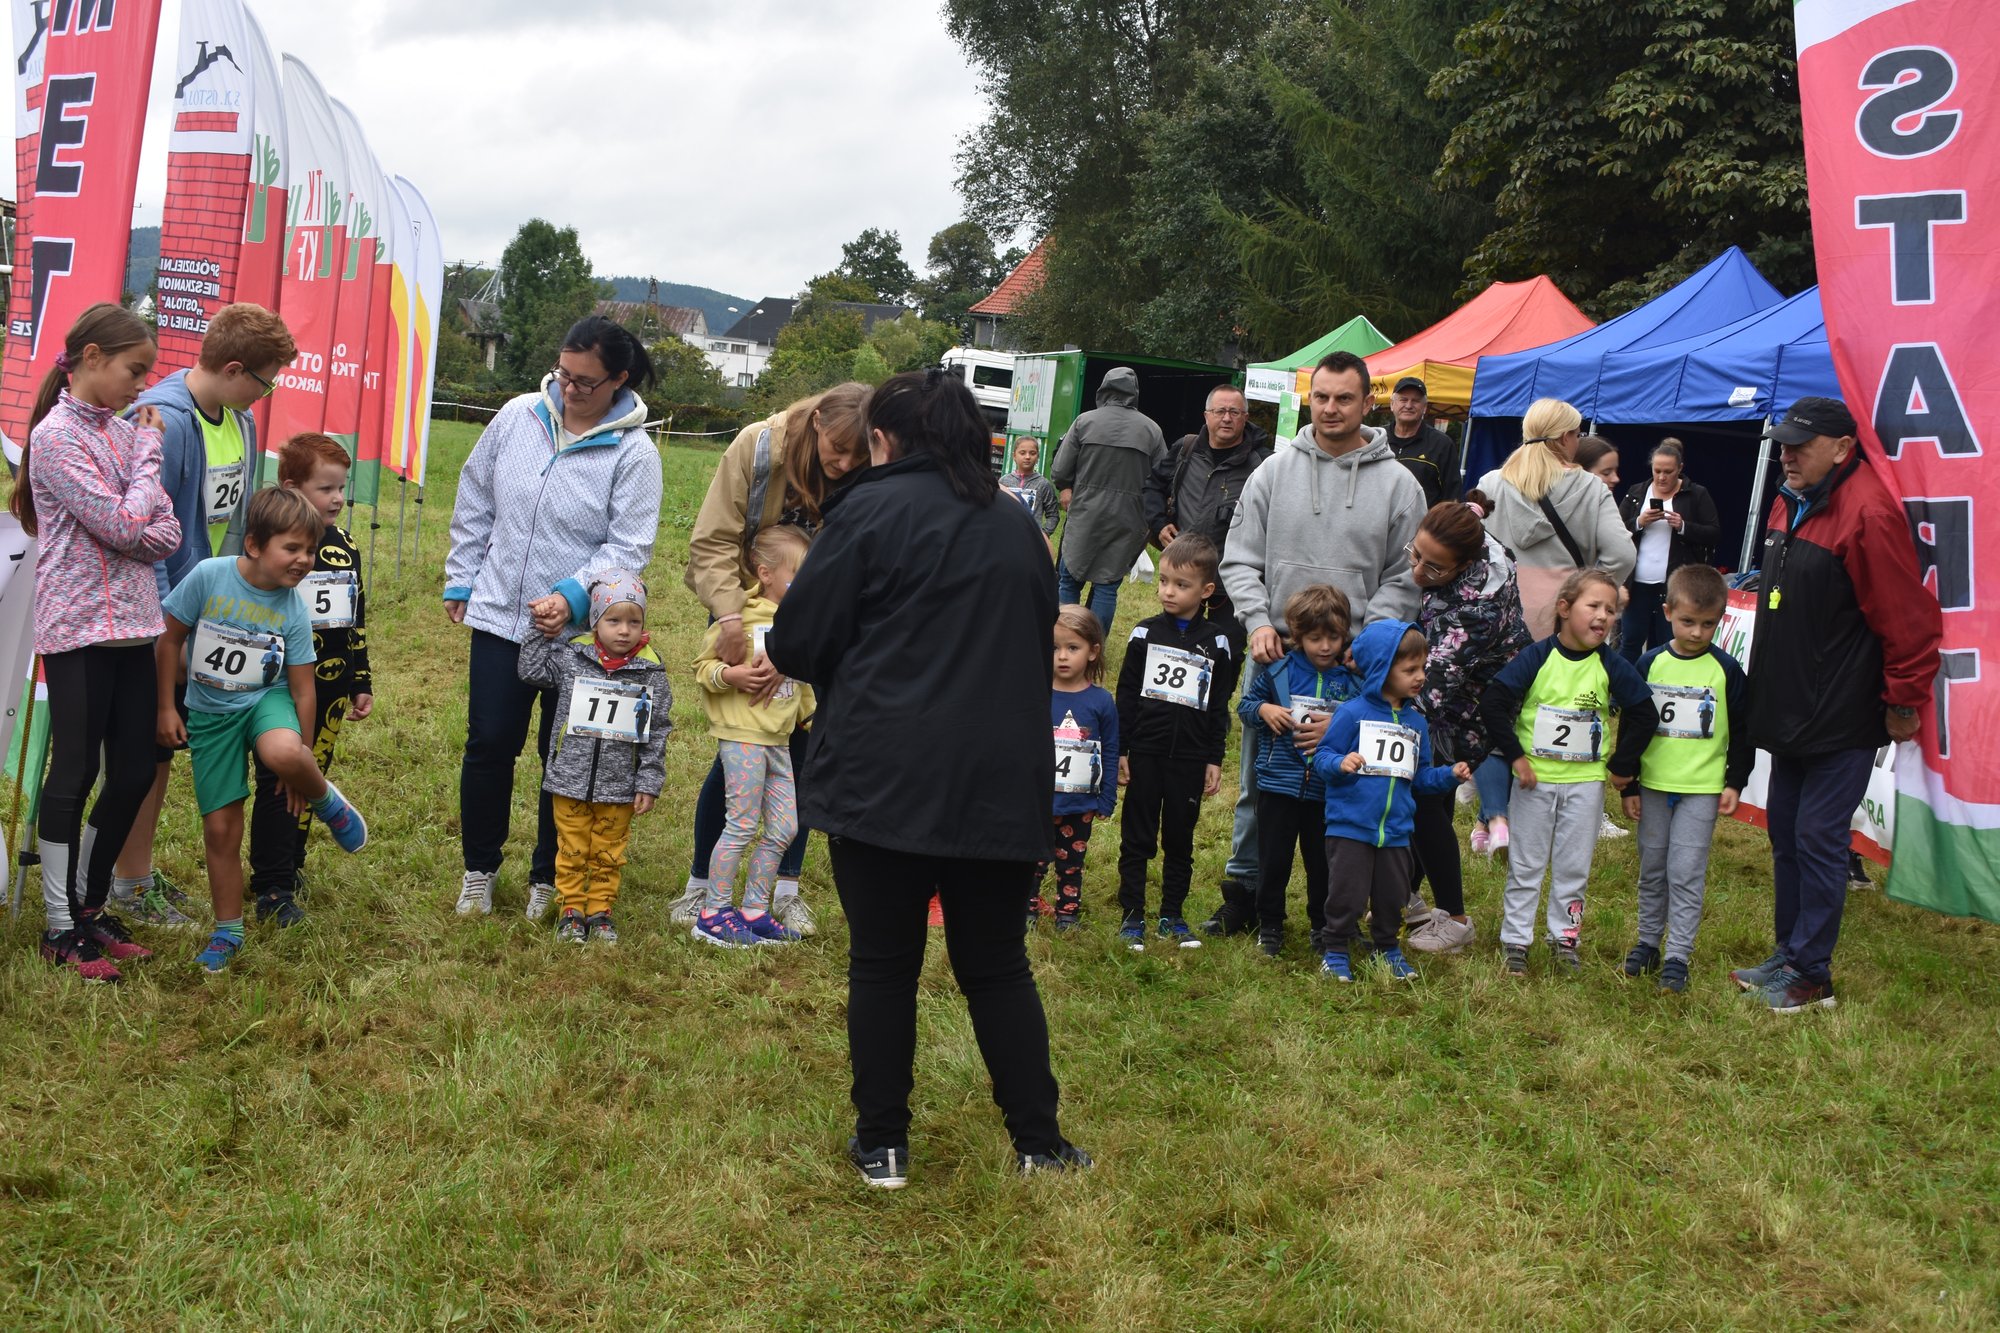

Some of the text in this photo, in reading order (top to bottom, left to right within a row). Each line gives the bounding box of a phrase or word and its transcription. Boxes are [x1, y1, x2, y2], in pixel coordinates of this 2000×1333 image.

[213, 480, 240, 509] 26
[315, 589, 331, 614] 5
[204, 646, 247, 676] 40
[1153, 663, 1187, 689] 38
[587, 697, 619, 724] 11
[1660, 701, 1676, 723] 6
[1552, 724, 1571, 747] 2
[1375, 738, 1405, 763] 10
